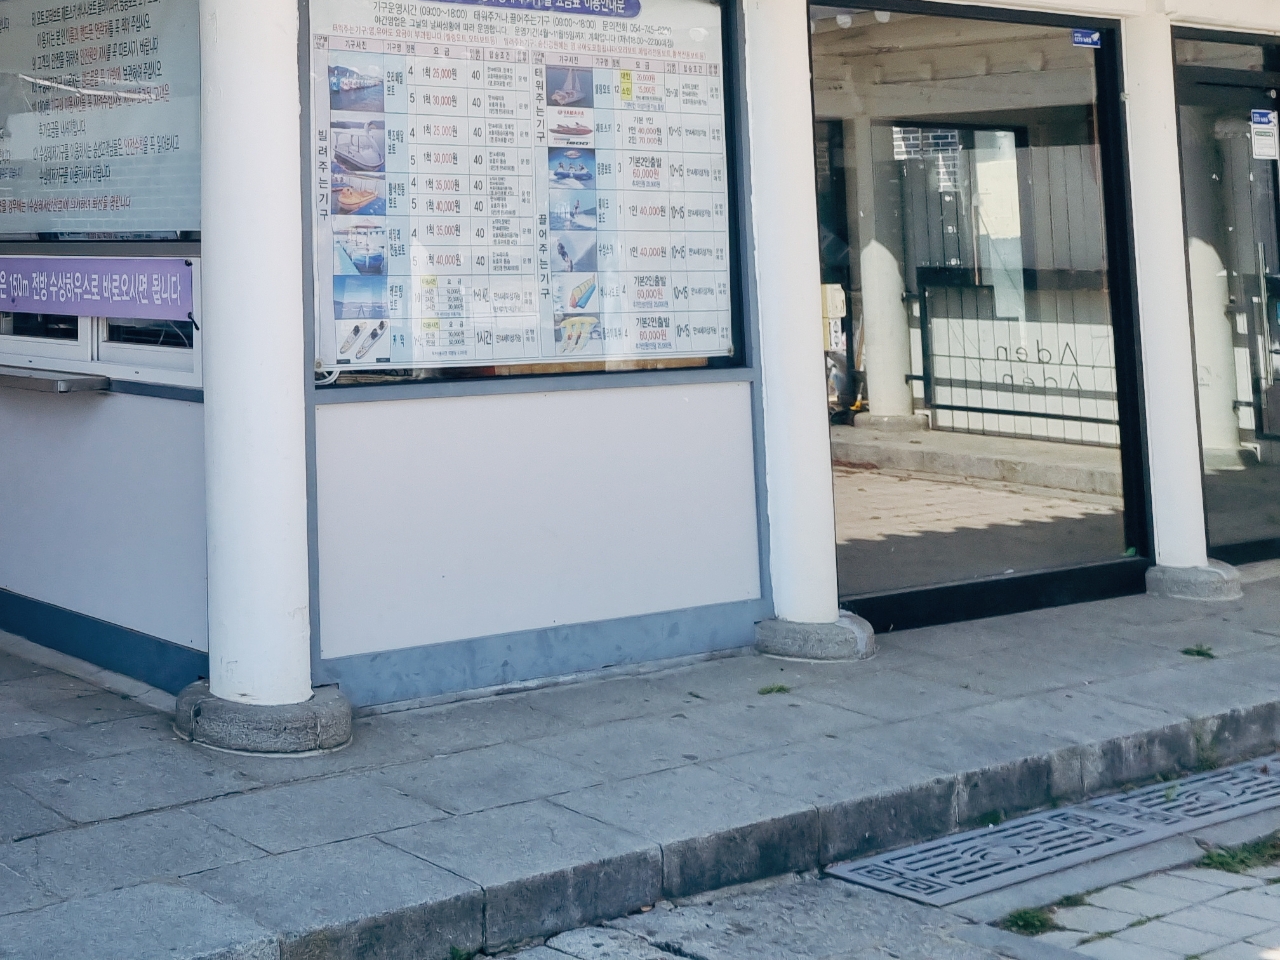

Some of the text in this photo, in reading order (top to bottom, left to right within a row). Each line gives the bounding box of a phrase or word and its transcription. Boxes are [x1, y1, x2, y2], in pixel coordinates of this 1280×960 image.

[373, 1, 417, 17] 기구운영시간
[602, 20, 628, 33] 문의전화
[408, 65, 414, 75] 4
[471, 70, 481, 81] 40
[472, 97, 481, 108] 40
[409, 127, 415, 138] 4
[473, 127, 483, 138] 40
[473, 154, 483, 165] 40
[411, 177, 417, 188] 4
[474, 180, 483, 191] 40
[474, 201, 484, 212] 40
[639, 205, 666, 217] 40,000원
[411, 228, 418, 238] 4
[475, 228, 485, 238] 40
[639, 244, 667, 257] 40,000원
[475, 255, 485, 266] 40
[9, 273, 29, 298] 150m
[32, 272, 48, 300] 전방
[49, 271, 100, 302] 수상하우스로
[103, 273, 149, 304] 바로오시면
[152, 272, 181, 306] 됩니다
